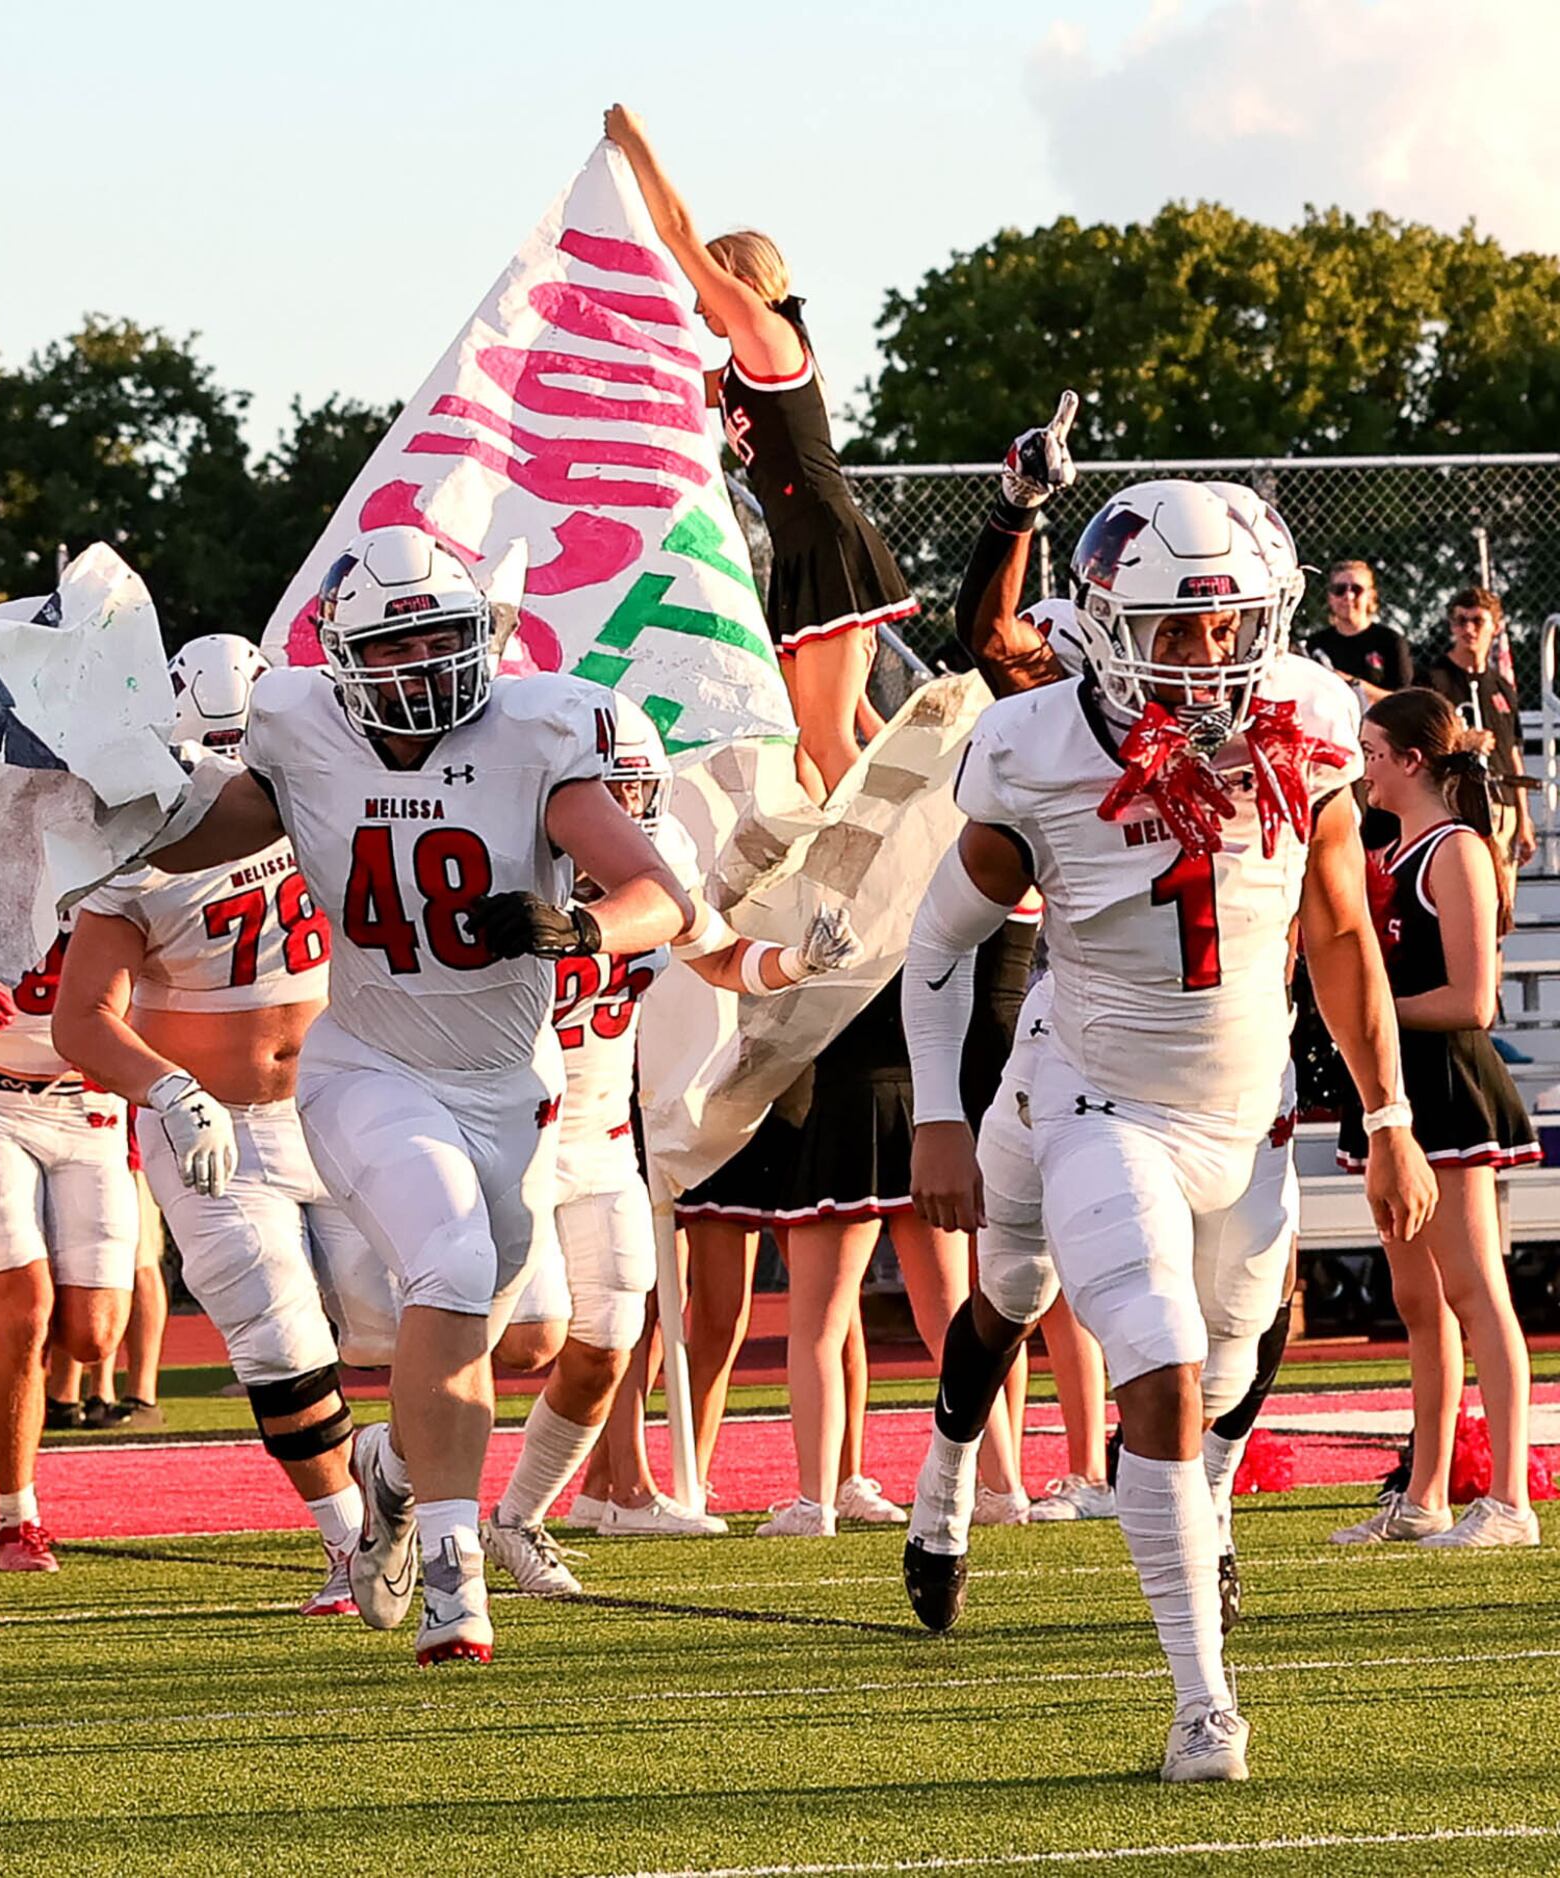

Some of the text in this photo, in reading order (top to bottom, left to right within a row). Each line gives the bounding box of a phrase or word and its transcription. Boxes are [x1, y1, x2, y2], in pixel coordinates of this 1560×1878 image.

[365, 798, 445, 820] MELISSA
[202, 871, 333, 987] 78
[343, 826, 496, 976] 48
[1150, 847, 1222, 992] 1
